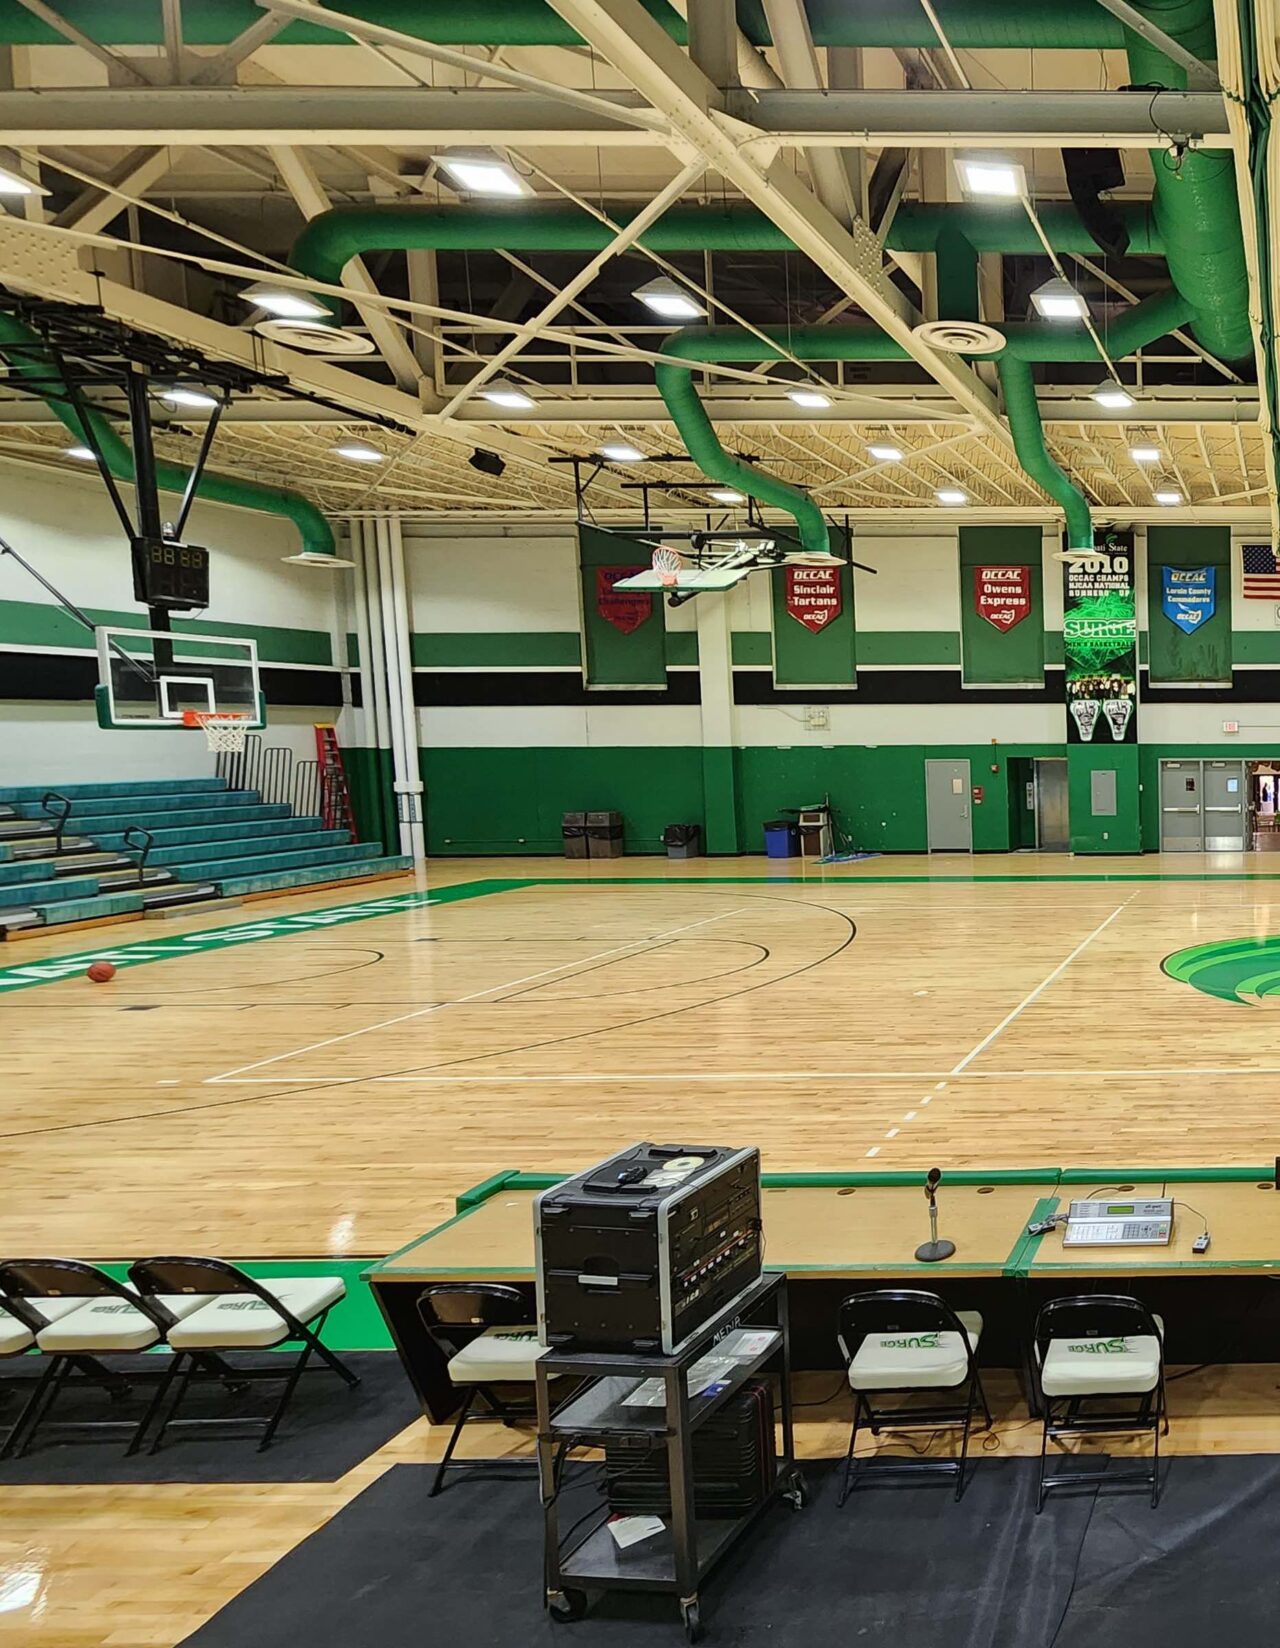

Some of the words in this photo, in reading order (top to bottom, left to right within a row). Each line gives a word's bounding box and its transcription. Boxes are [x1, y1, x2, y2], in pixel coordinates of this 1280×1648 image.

[1108, 543, 1128, 552] State
[1068, 556, 1129, 574] 2010
[794, 570, 833, 580] OCCAC
[981, 570, 1021, 580] OCCAC
[1069, 574, 1095, 582] OCCAC
[1096, 574, 1129, 582] CHAMPS
[1171, 572, 1207, 582] OCCAC
[793, 584, 836, 595] Sinclair
[983, 583, 1022, 594] Owens
[1188, 588, 1211, 596] County
[793, 596, 838, 606] Tartans
[980, 595, 1026, 607] Express
[1064, 619, 1137, 638] SURGE
[182, 899, 443, 942] STATE
[713, 1316, 743, 1347] MEDIA
[1067, 1337, 1128, 1354] SURGE
